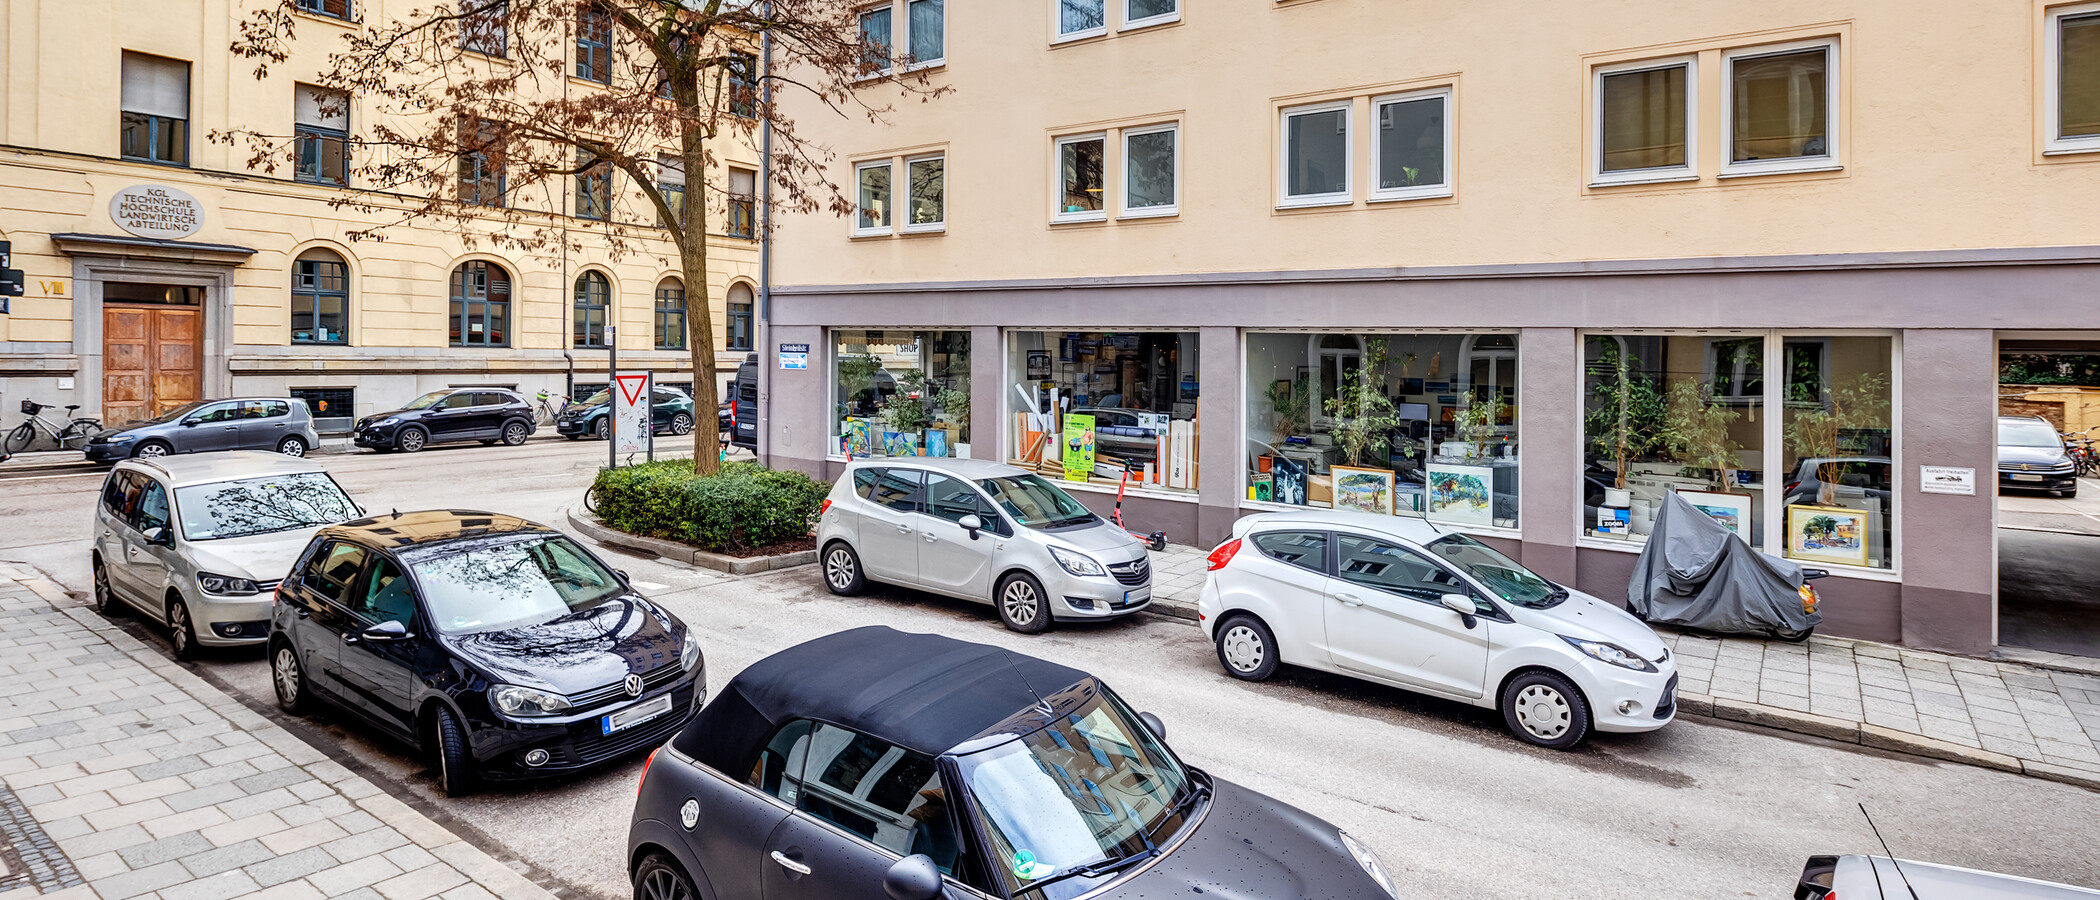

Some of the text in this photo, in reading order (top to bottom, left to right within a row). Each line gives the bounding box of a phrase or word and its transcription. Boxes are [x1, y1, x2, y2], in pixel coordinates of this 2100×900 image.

[124, 194, 192, 208] TECHNISCHE
[120, 202, 196, 217] HOCHSCHULE
[127, 220, 190, 232] ABTEILUNG
[899, 343, 919, 353] SHOP
